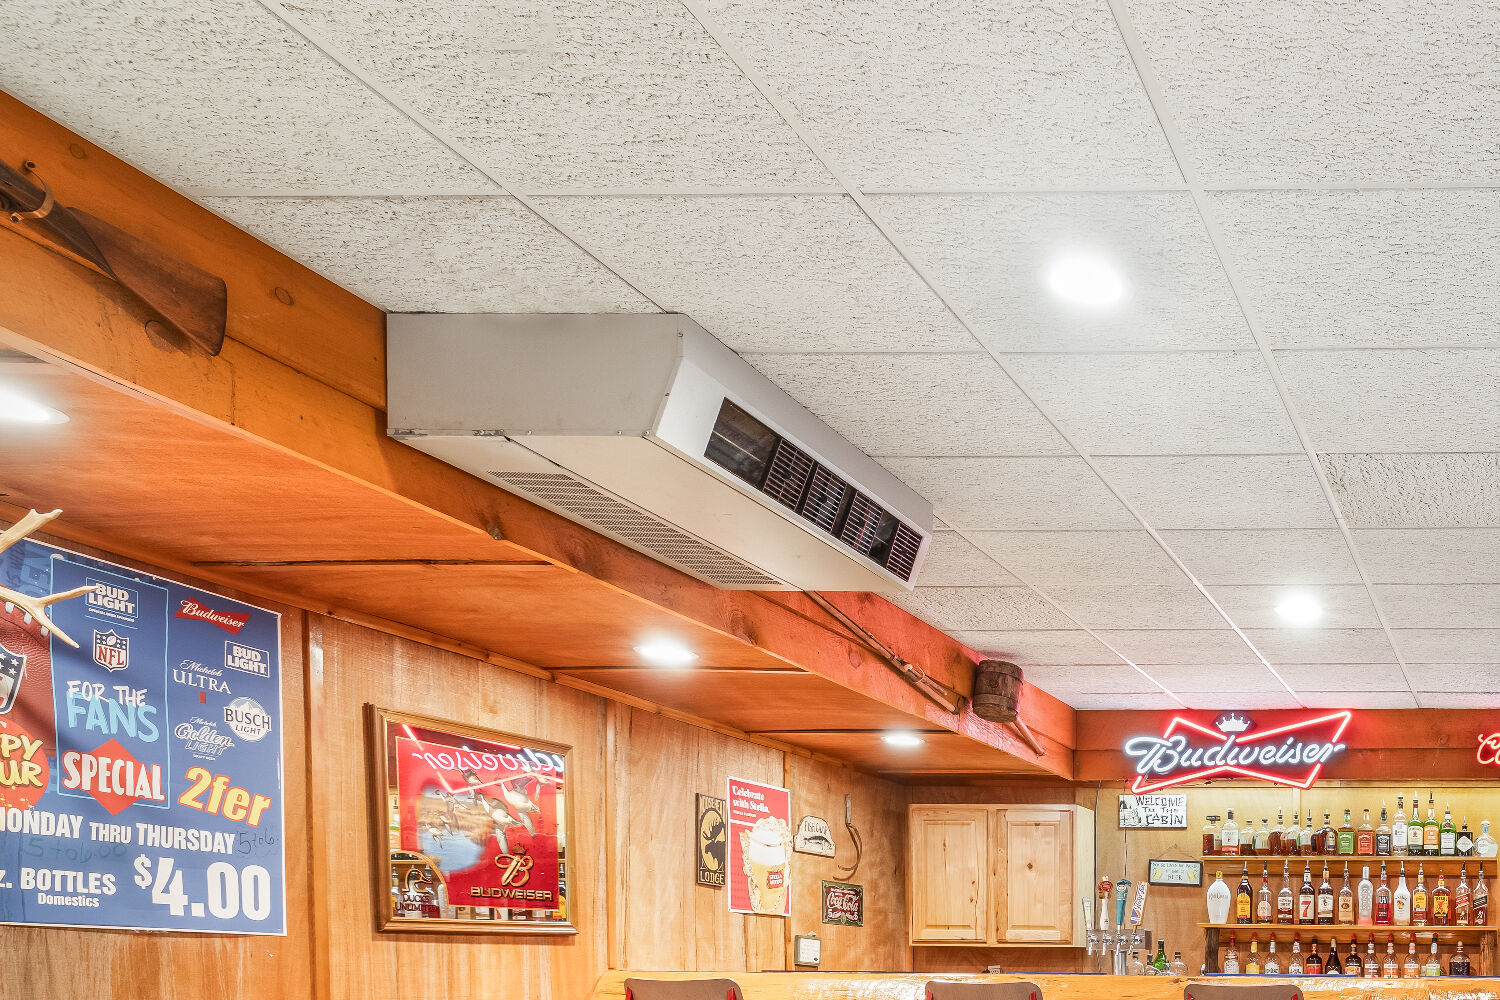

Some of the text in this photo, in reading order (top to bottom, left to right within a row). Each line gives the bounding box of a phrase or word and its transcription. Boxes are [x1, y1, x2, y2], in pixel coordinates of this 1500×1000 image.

[95, 582, 130, 601] BUD
[88, 593, 135, 614] LIGHT
[180, 599, 246, 629] Budweiser
[97, 645, 125, 666] NFL
[232, 645, 262, 662] BUD
[179, 659, 223, 677] Michelob
[227, 654, 268, 675] LIGHT
[172, 668, 232, 695] ULTRA
[66, 680, 148, 708] FOR THE
[66, 691, 160, 743] FANS
[225, 707, 271, 731] BUSCH
[174, 722, 235, 748] Golden
[235, 724, 262, 736] LIGHT
[1124, 733, 1347, 776] Budweiser
[0, 760, 43, 788] UR
[63, 752, 166, 801] SPECIAL
[179, 767, 272, 827] 2fer
[731, 785, 765, 801] Celebrate
[732, 798, 750, 809] with
[1146, 813, 1184, 826] CABIN
[89, 821, 132, 844] THRU
[136, 823, 236, 855] THURSDAY
[20, 867, 117, 896] BOTTLES
[133, 853, 272, 922] $4.00
[700, 871, 725, 885] LODGE
[37, 892, 100, 908] Domestics
[470, 886, 553, 901] BUDWEISER
